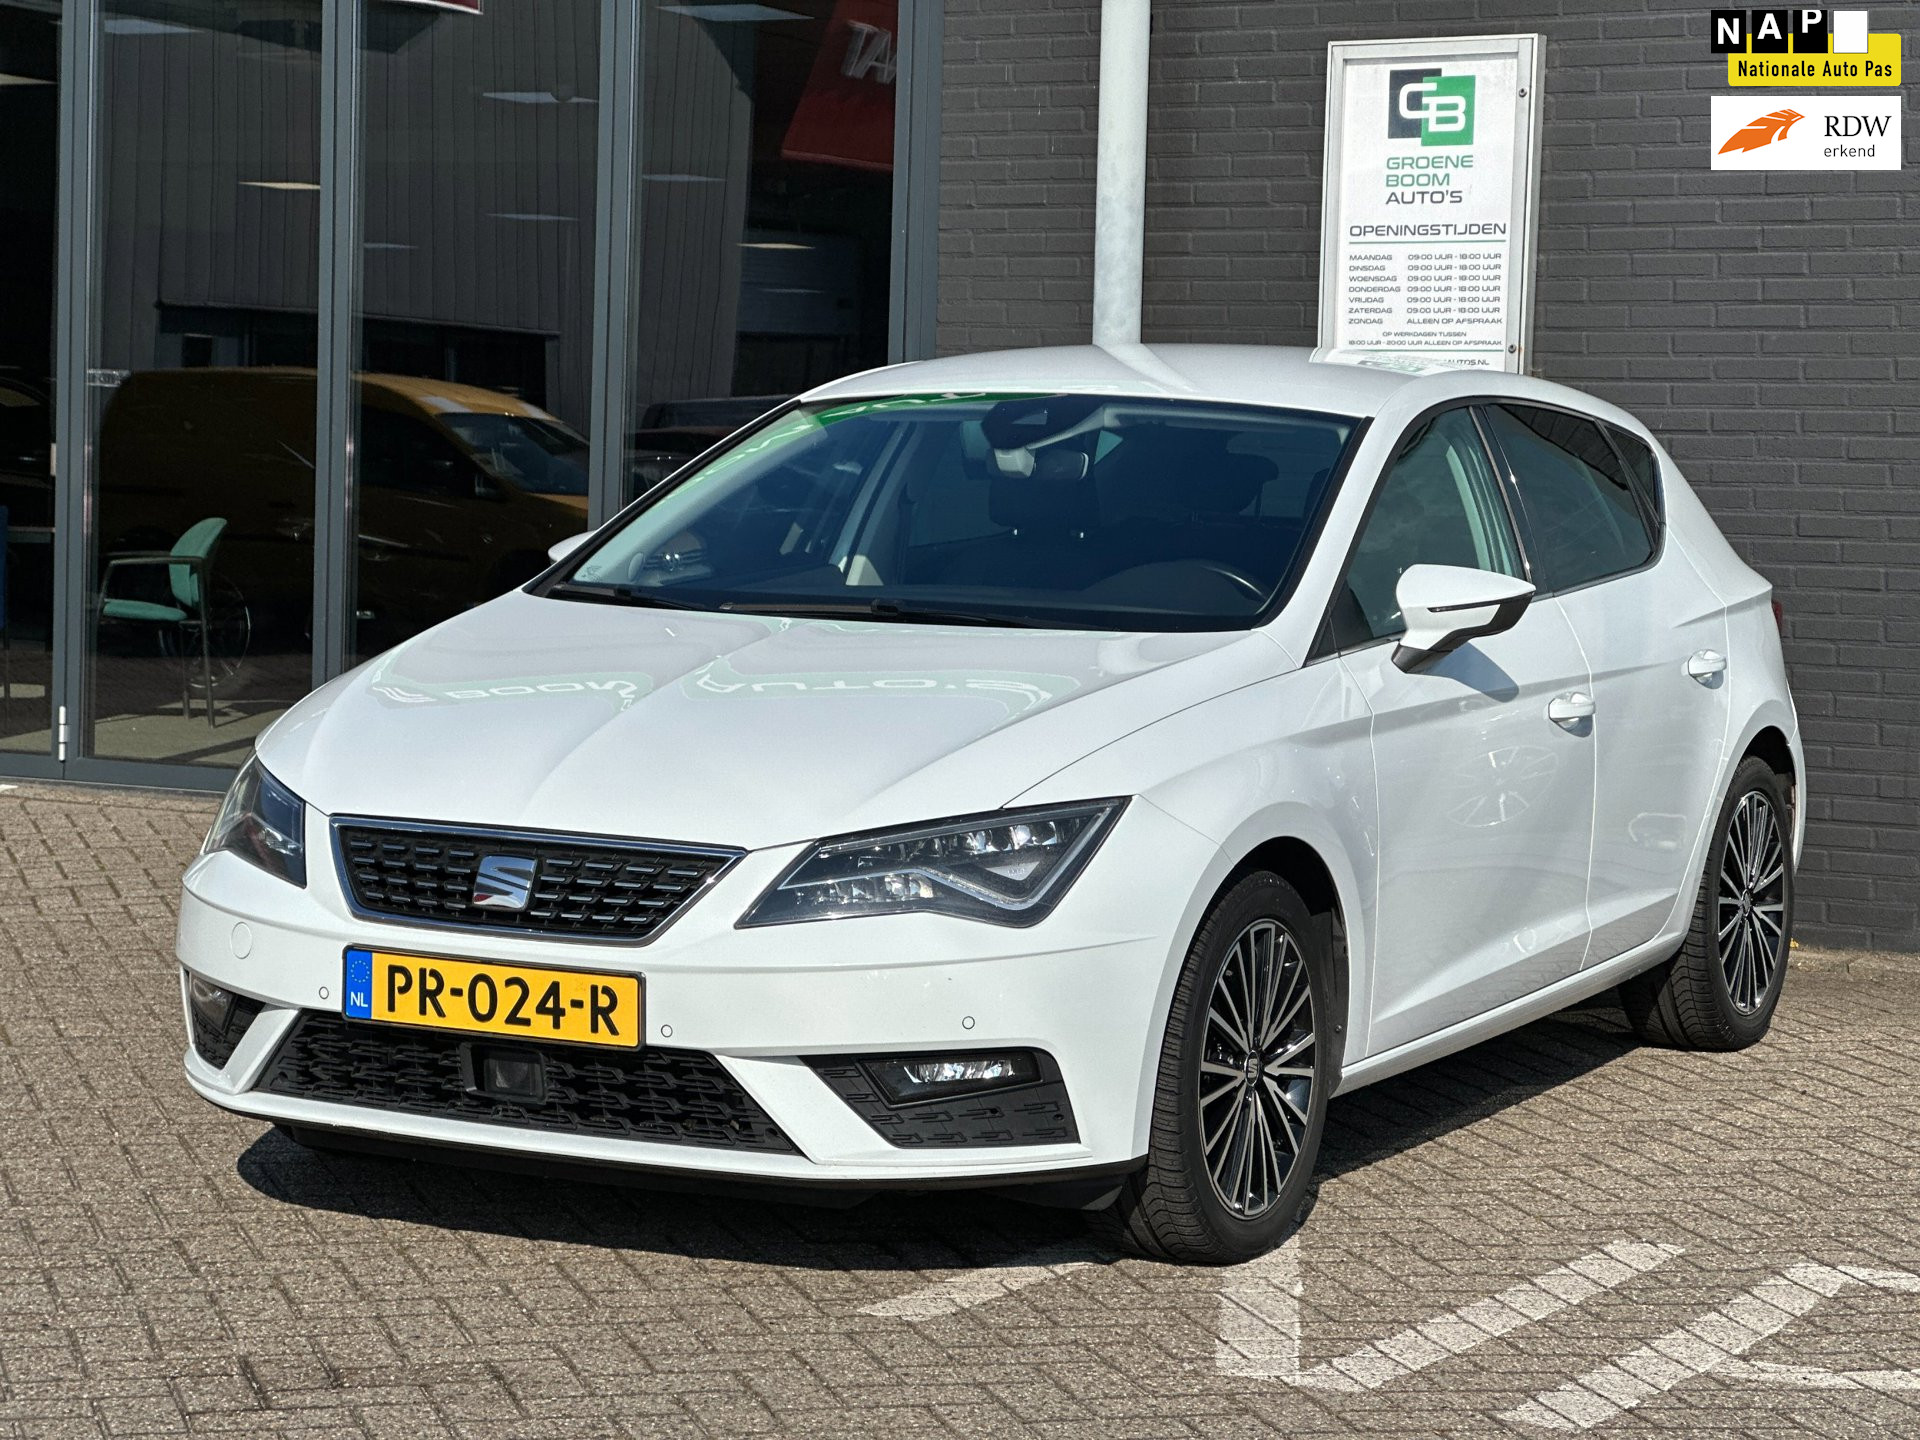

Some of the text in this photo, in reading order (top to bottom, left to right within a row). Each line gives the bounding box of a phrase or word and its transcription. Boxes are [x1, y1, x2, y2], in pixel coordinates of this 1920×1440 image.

[1386, 154, 1474, 170] GROENE
[1385, 173, 1450, 188] BOOM
[1385, 189, 1463, 205] AUTO'S
[1349, 222, 1507, 237] OPENINGSTIJDEN
[350, 963, 620, 1036] NL PR-024-R
